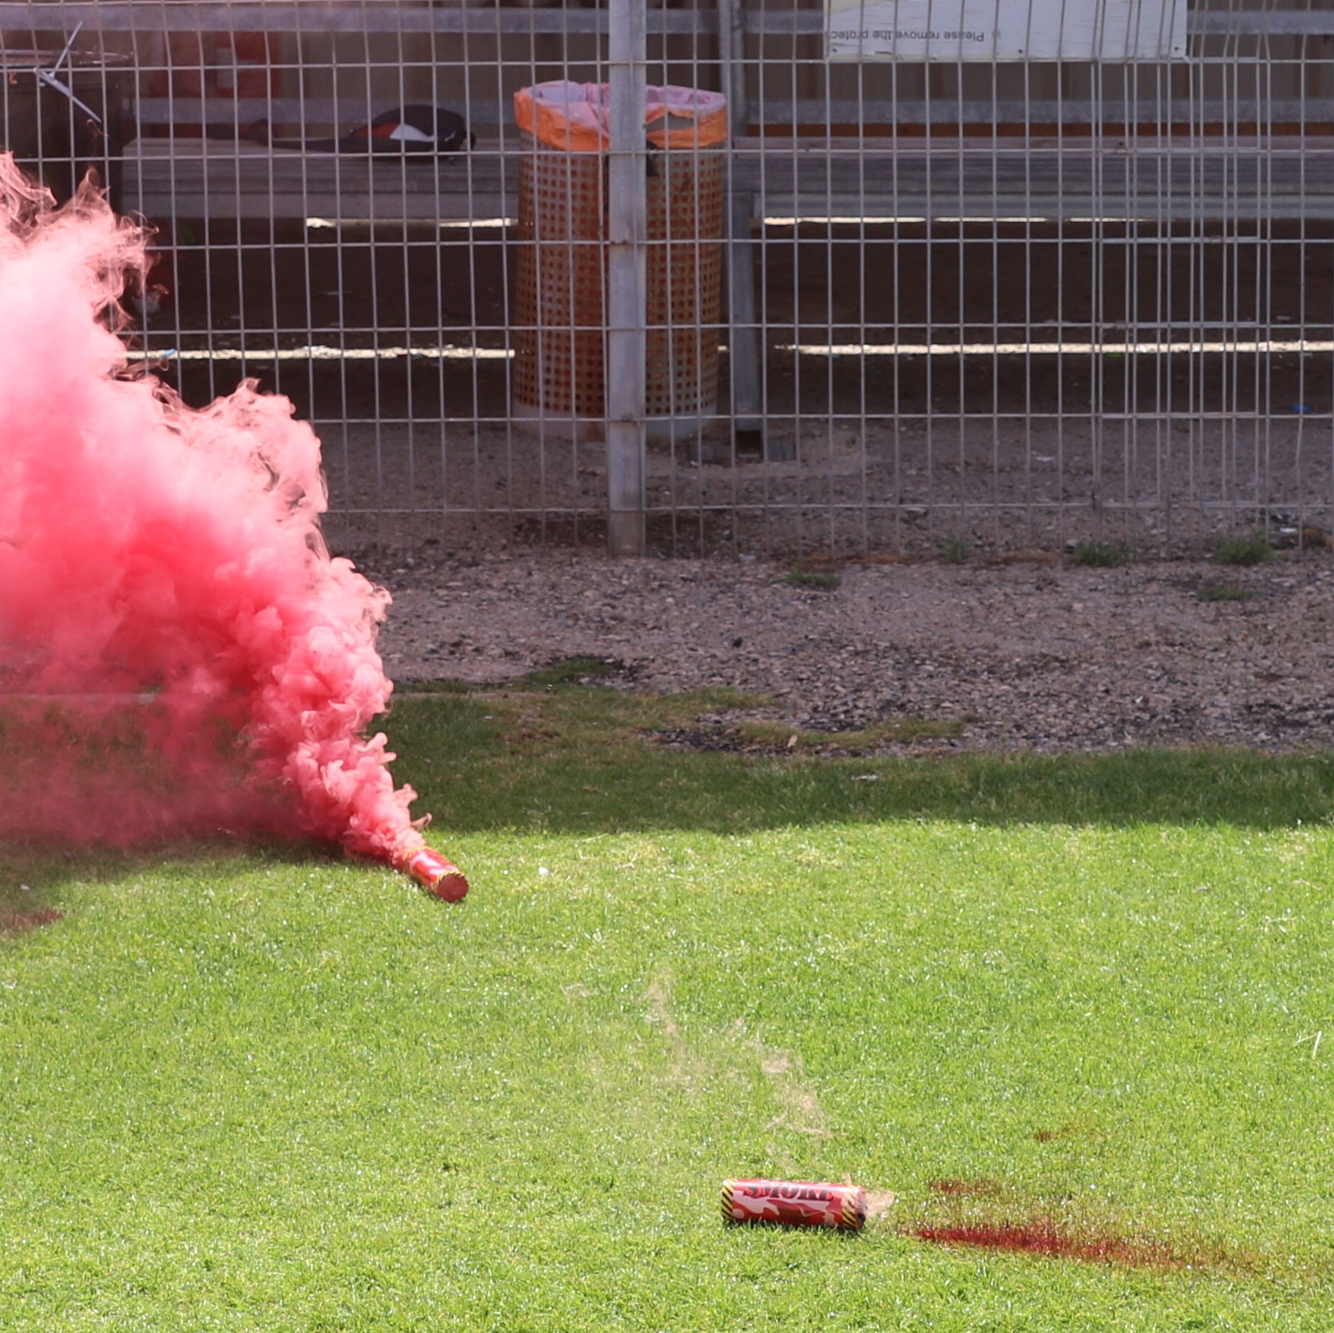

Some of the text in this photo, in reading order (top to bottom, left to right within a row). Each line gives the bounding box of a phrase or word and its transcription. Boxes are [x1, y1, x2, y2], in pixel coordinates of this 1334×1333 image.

[872, 31, 892, 42] the
[895, 31, 940, 41] remove
[944, 31, 985, 43] Please
[742, 1185, 834, 1202] SMOKE
